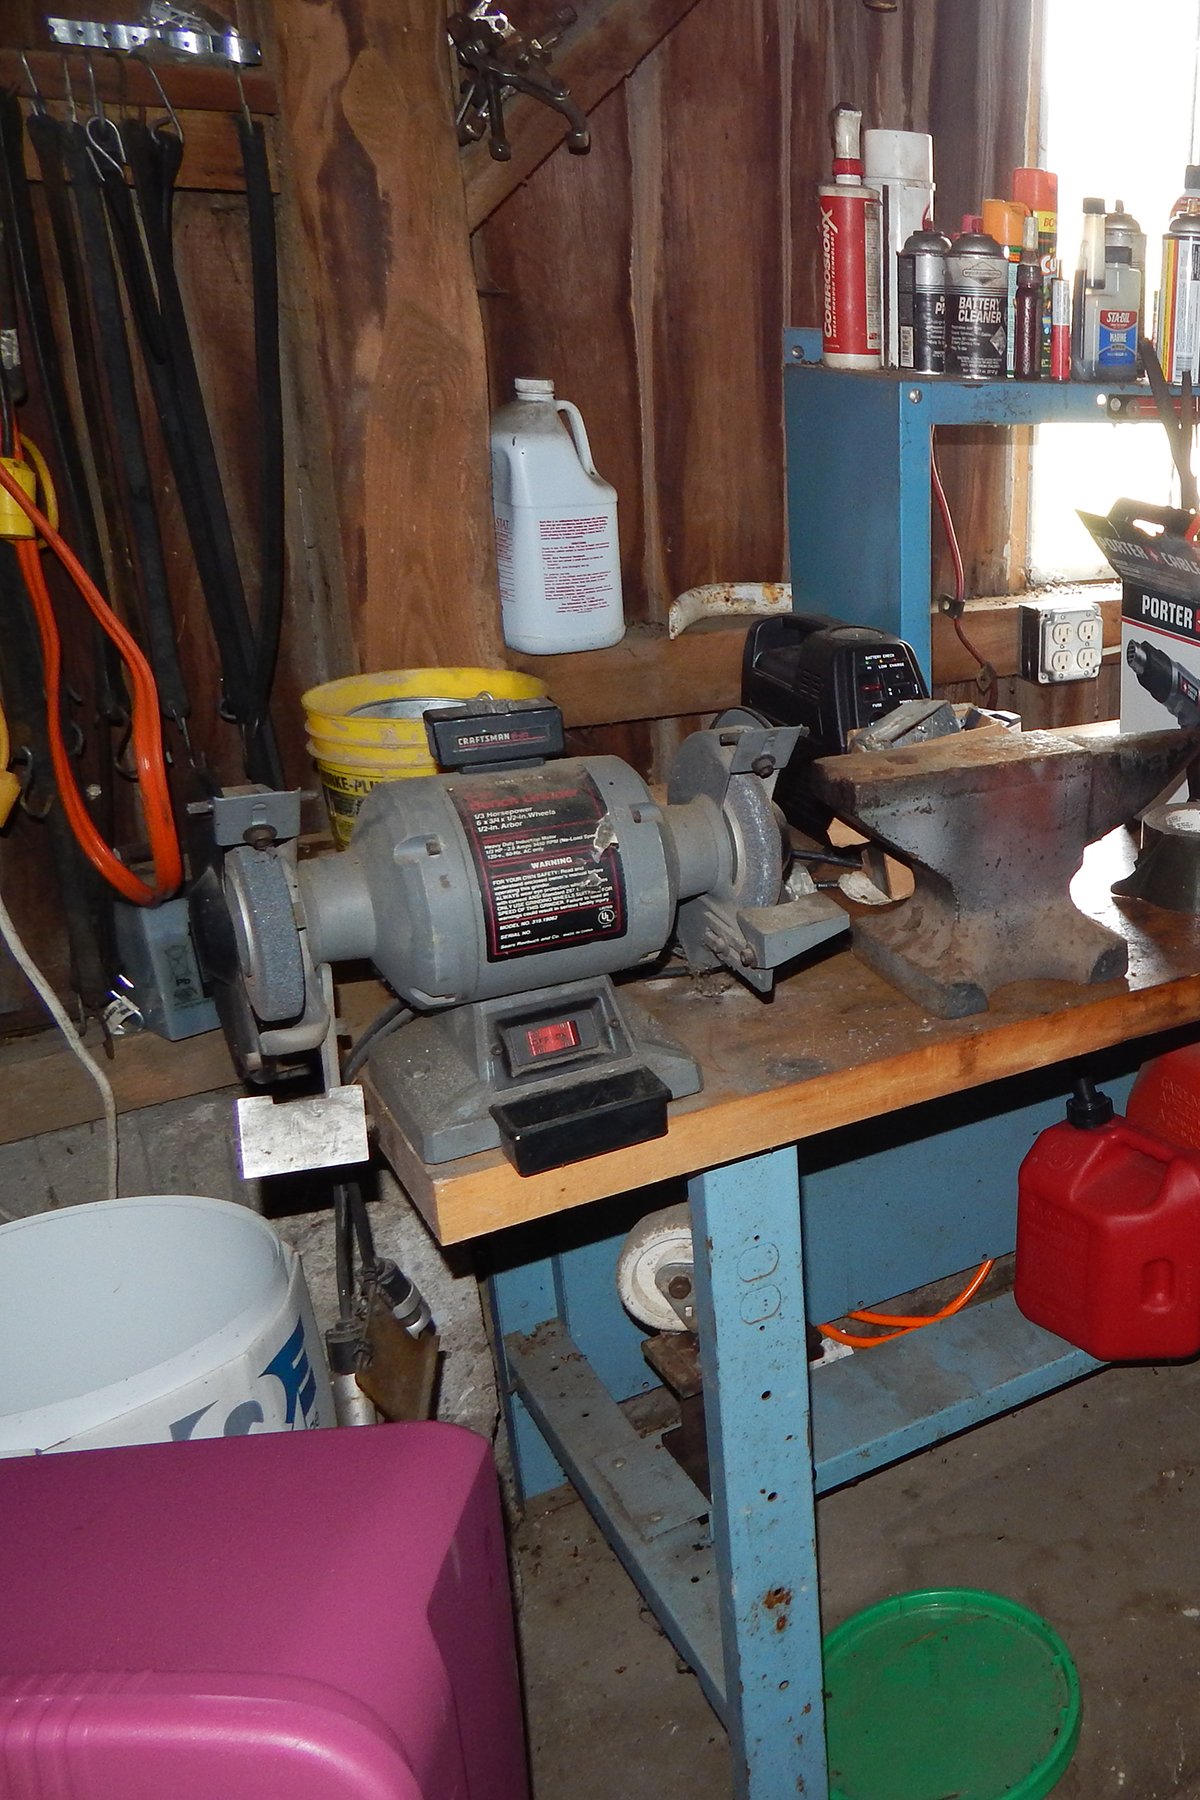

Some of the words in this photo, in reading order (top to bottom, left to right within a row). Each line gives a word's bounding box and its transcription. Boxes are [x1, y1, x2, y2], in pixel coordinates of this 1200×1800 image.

[959, 296, 1001, 311] BATTERY
[958, 309, 1002, 323] CLEANER
[1097, 536, 1149, 560] PORTER
[1142, 595, 1193, 630] PORTER
[458, 732, 510, 746] CRAFTSMAN
[487, 807, 533, 818] Horsepower
[477, 824, 500, 833] 1/2-in.
[501, 820, 523, 830] Arbor
[531, 857, 573, 869] WARNING
[496, 893, 520, 901] ALWAYS
[601, 912, 612, 922] UL
[500, 932, 520, 940] SERIAL
[176, 978, 191, 987] Pb
